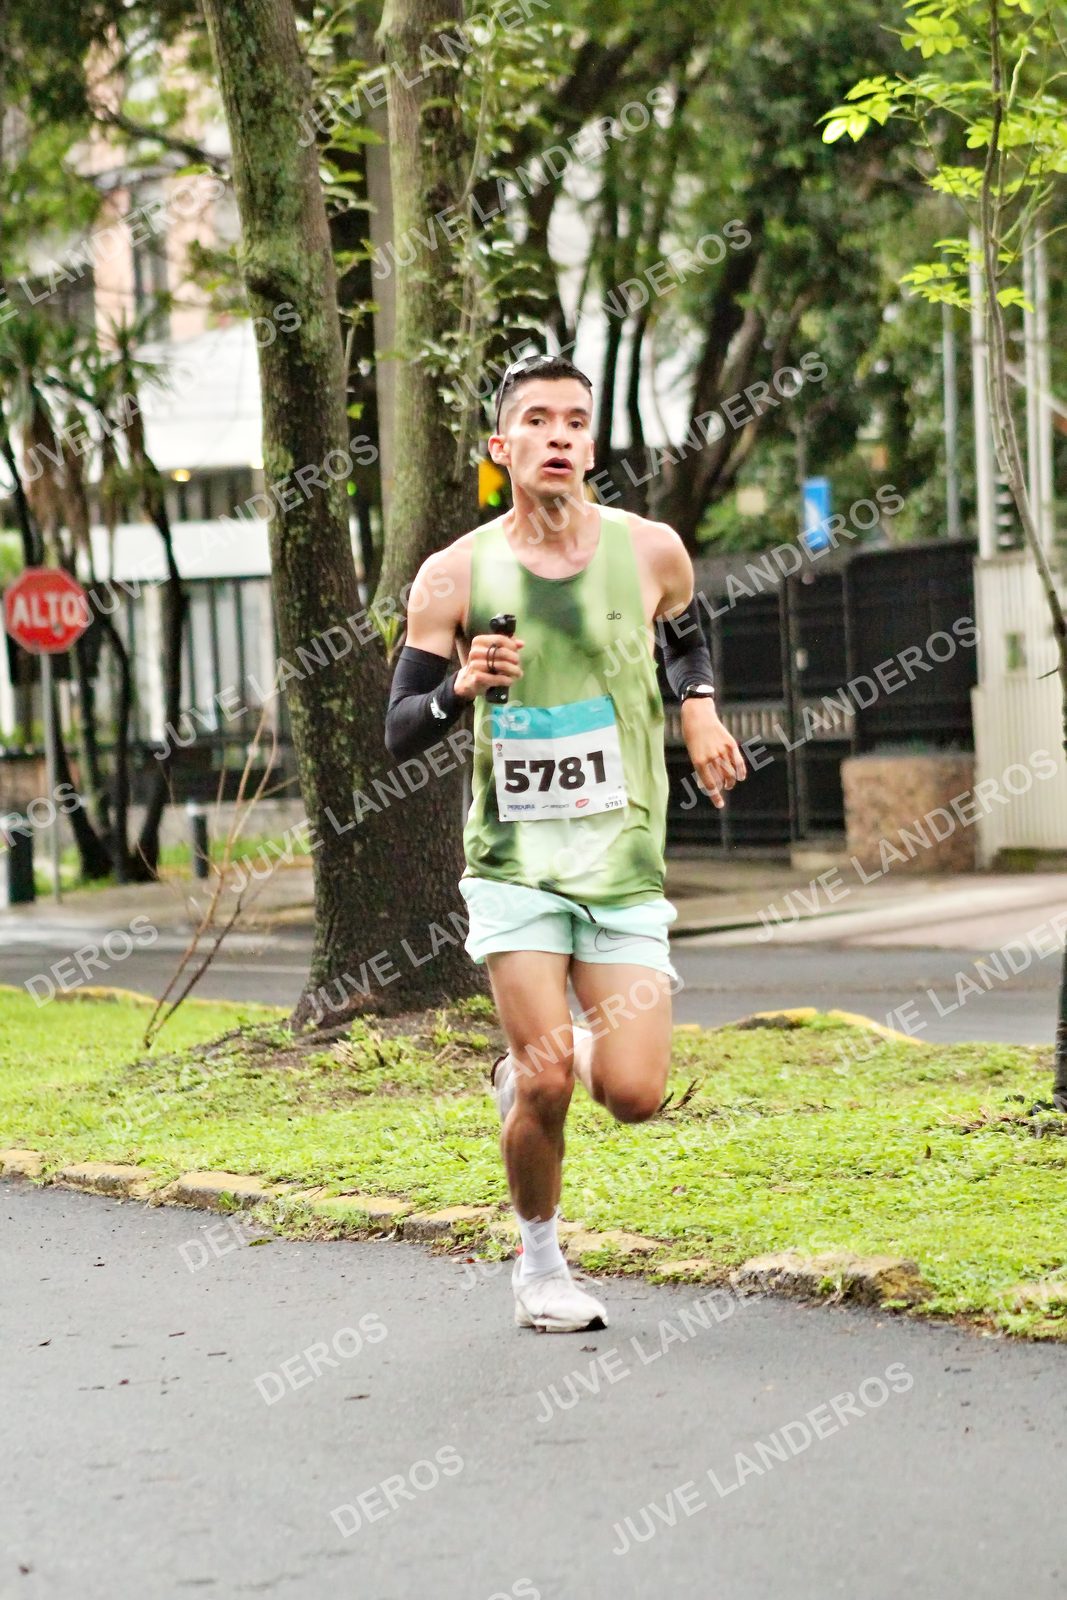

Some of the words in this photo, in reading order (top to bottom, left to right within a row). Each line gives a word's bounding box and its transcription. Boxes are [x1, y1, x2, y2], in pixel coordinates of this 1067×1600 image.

[11, 591, 80, 629] ALTO
[504, 750, 606, 794] 5781
[605, 800, 622, 808] 5781
